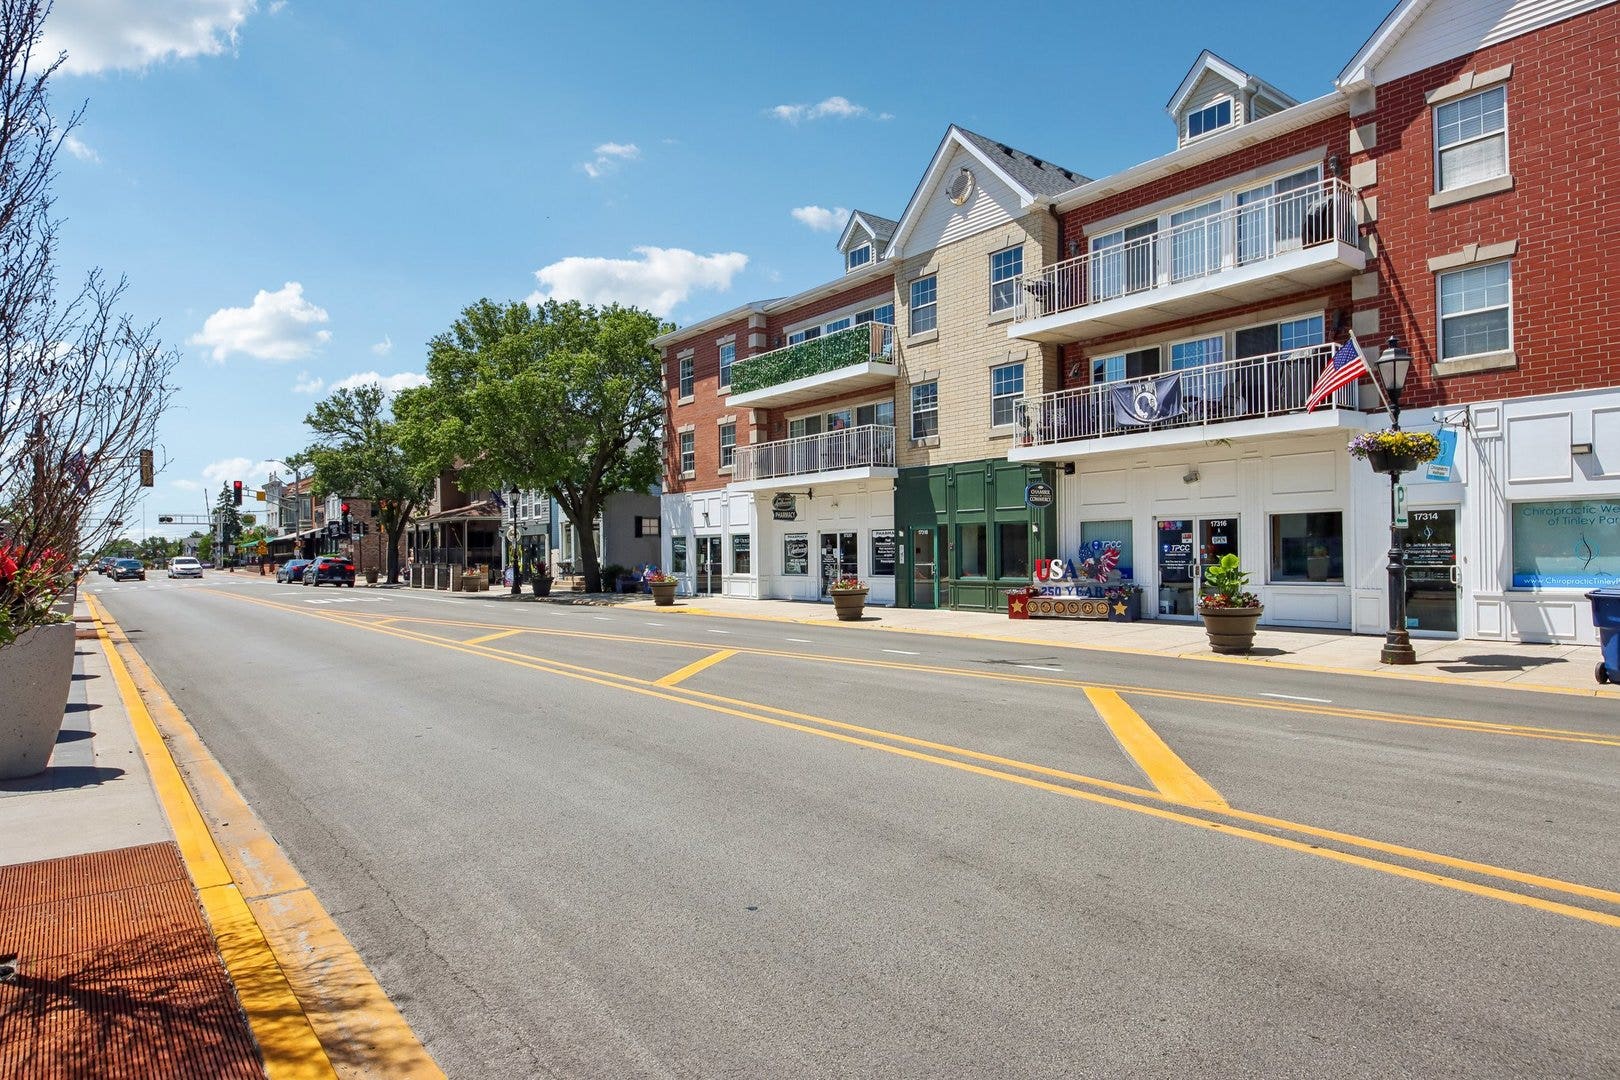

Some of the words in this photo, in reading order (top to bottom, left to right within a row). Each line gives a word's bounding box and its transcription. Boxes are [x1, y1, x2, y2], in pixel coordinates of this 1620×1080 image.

[774, 510, 796, 519] PHARMACY
[1522, 504, 1597, 517] Chiropractic
[1413, 513, 1439, 521] 17314
[1547, 517, 1560, 526] of
[1562, 516, 1597, 526] Tinley
[1101, 540, 1122, 548] TPCC
[1171, 544, 1191, 552] TPCC
[1035, 558, 1078, 581] USA
[1041, 586, 1062, 596] 250
[1064, 586, 1106, 598] YEAR
